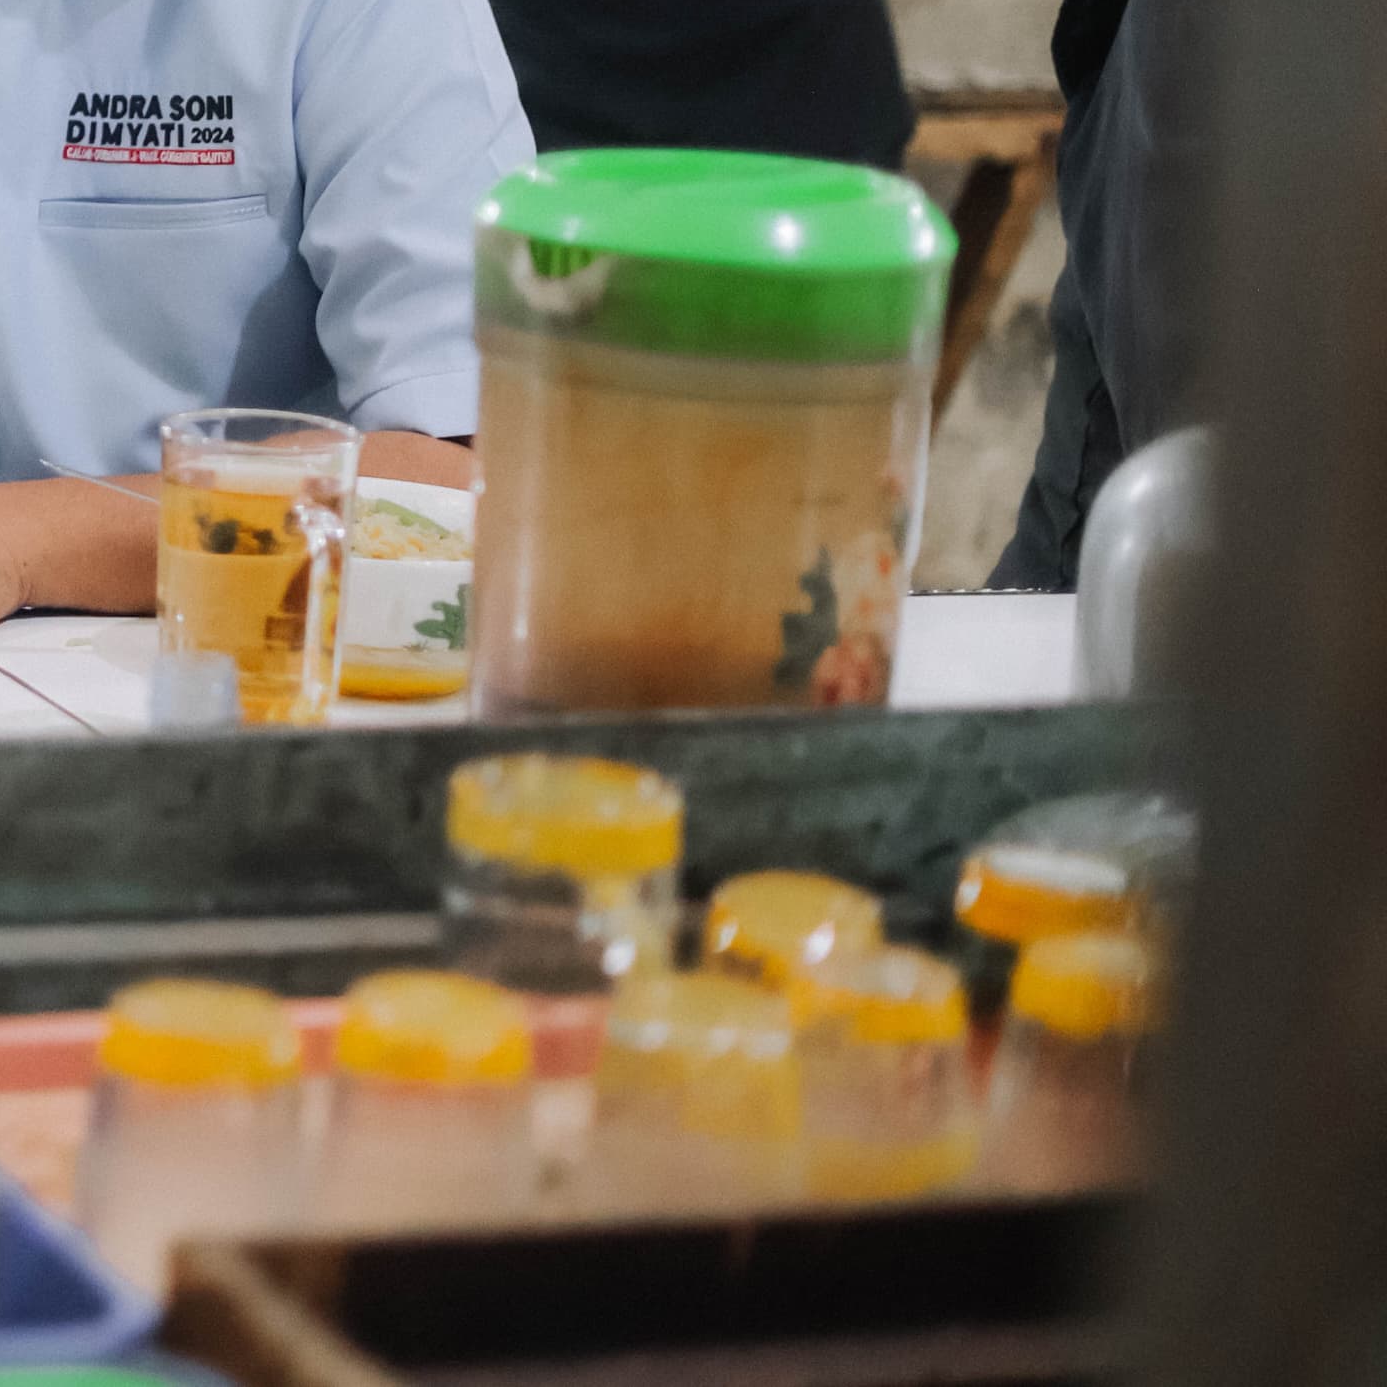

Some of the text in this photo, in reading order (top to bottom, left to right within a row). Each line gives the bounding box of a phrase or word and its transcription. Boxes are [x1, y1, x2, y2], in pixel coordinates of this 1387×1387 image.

[69, 92, 233, 121] ANDRA SONI
[66, 120, 235, 147] DIMYATI 2024
